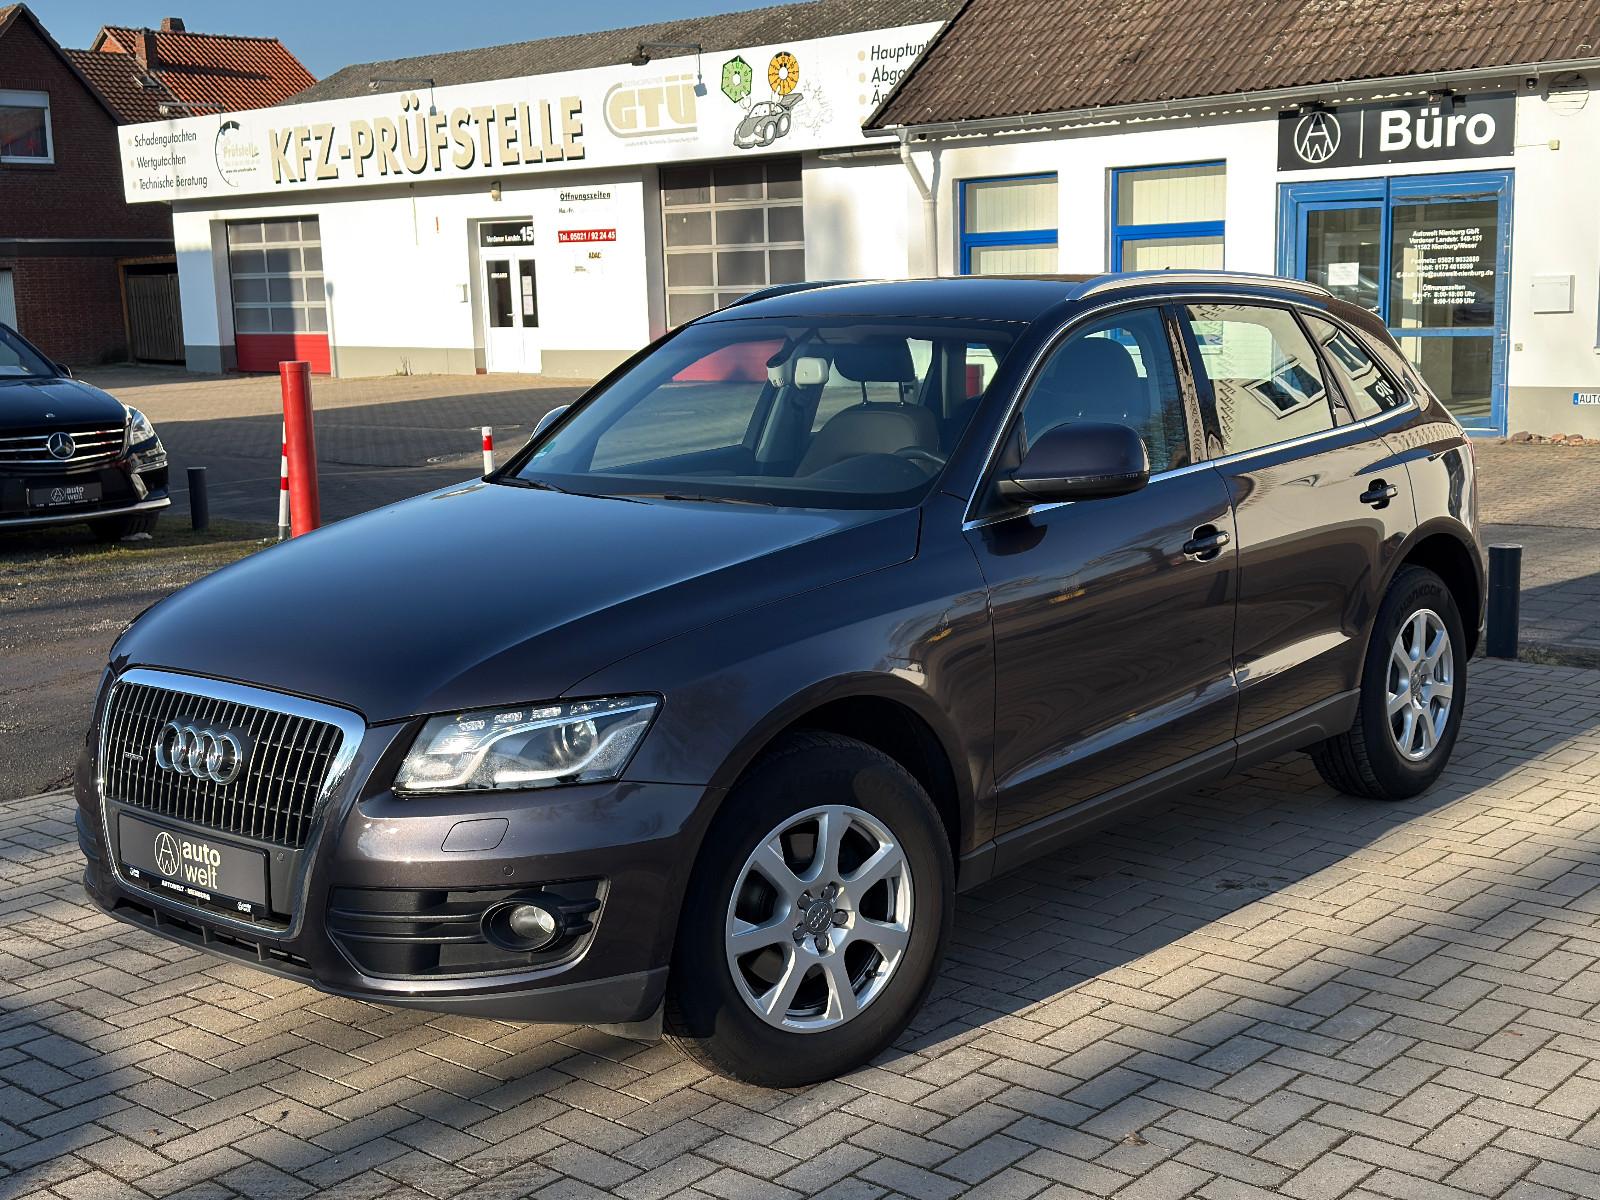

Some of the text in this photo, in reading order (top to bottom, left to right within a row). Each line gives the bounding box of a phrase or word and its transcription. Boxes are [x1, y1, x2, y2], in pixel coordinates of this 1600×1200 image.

[609, 74, 697, 129] GTÜ
[134, 129, 197, 148] Schadengutachten
[268, 93, 585, 184] KFZ-PRÜFSTELLE
[1379, 107, 1496, 152] Büro
[136, 152, 187, 170] Wertgutachten
[139, 174, 208, 190] Technische Beratung
[560, 190, 611, 201] Öffnungszeiten
[182, 841, 221, 867] auto
[184, 863, 218, 889] welt
